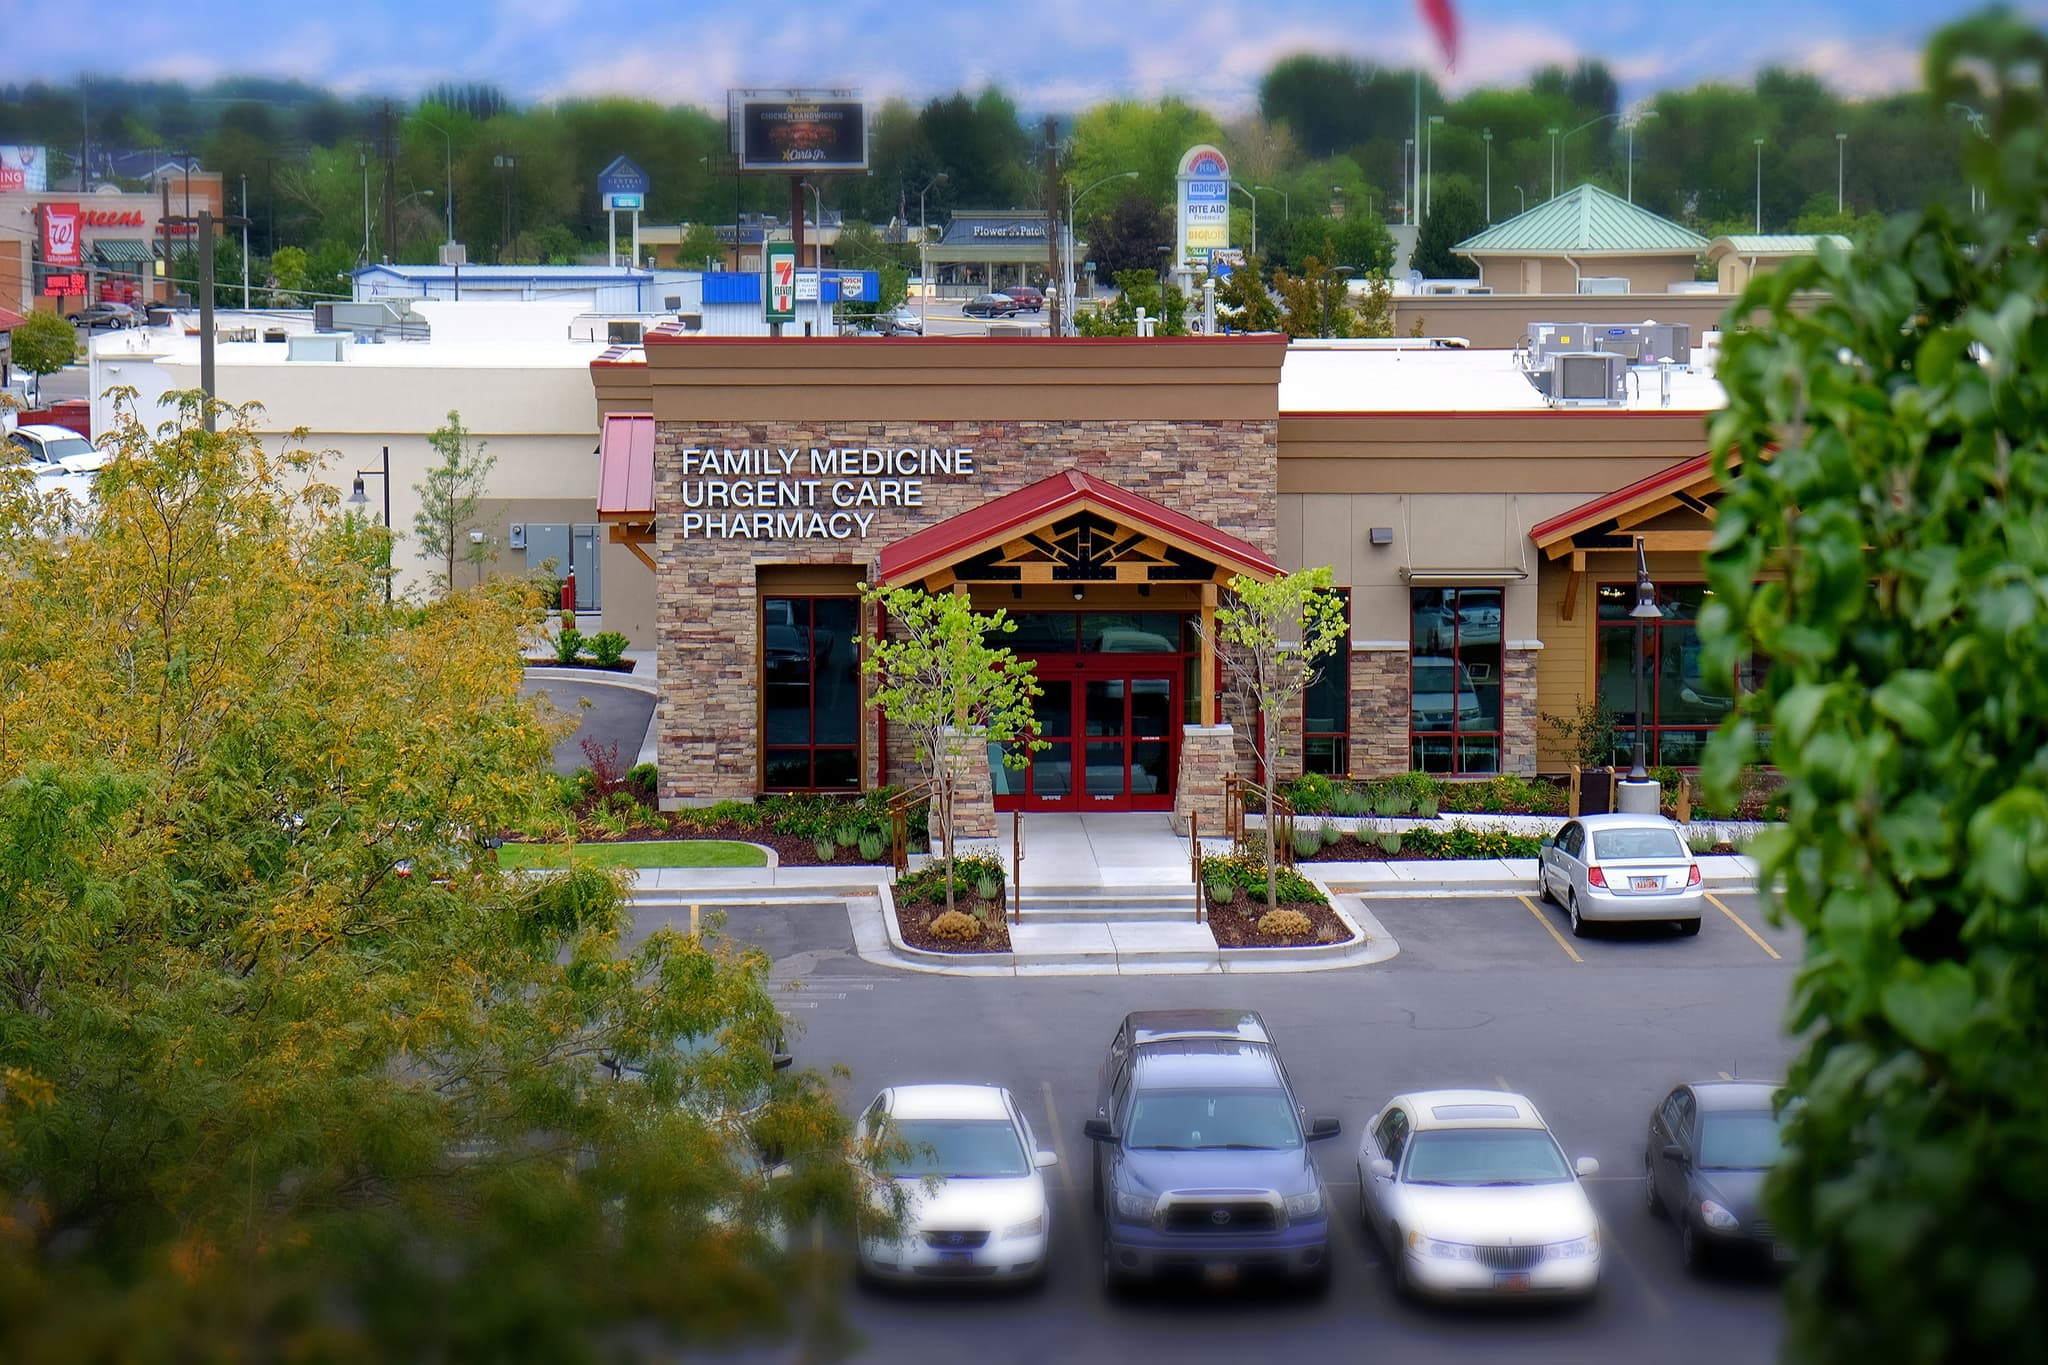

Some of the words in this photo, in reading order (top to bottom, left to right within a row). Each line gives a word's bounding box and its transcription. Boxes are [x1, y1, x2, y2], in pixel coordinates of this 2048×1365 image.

[760, 112, 793, 121] CHICKEN
[1188, 204, 1208, 214] RITE
[1210, 204, 1226, 214] AID
[973, 225, 1008, 237] Flower
[1020, 225, 1046, 237] Patch
[682, 447, 800, 475] FAMILY
[809, 447, 975, 475] MEDICINE
[681, 479, 822, 507] URGENT
[831, 479, 924, 507] CARE
[682, 511, 875, 539] PHARMACY
